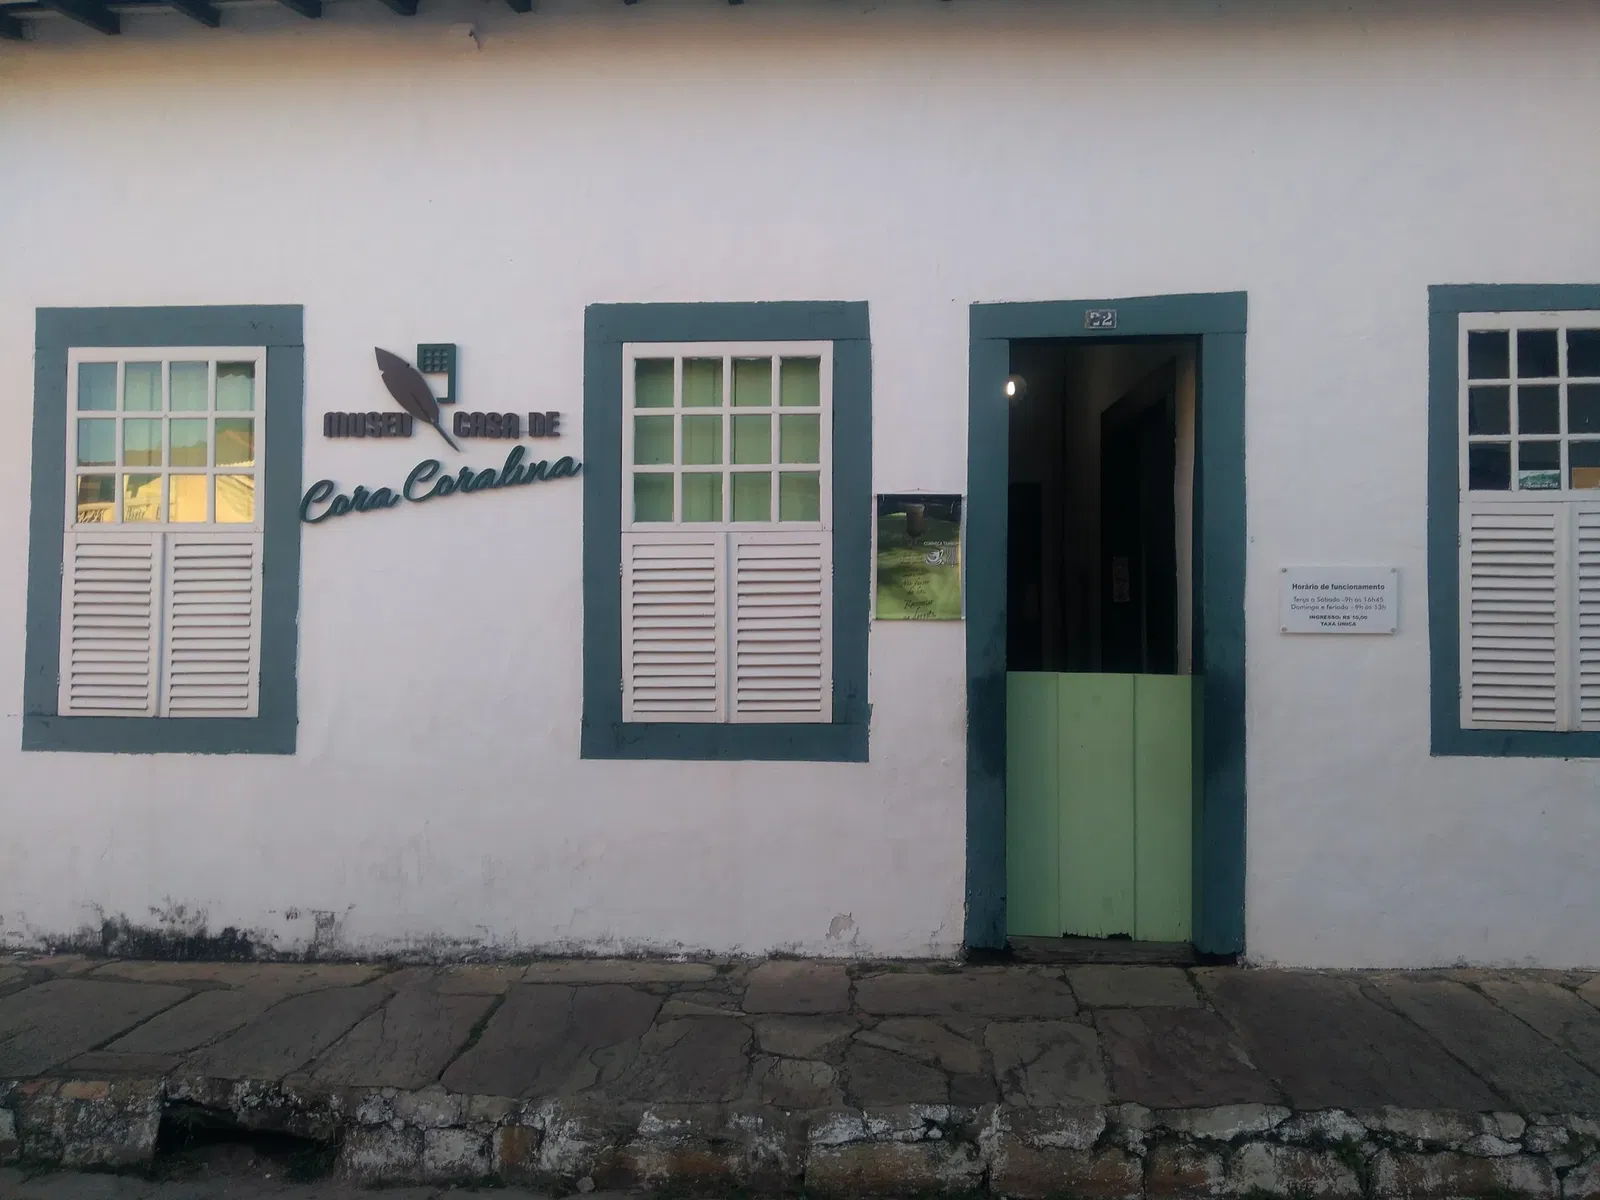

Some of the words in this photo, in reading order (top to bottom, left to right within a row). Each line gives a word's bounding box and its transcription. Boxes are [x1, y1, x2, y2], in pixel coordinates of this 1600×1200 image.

[323, 411, 413, 438] MUSEU
[453, 411, 520, 439] CASA
[528, 411, 561, 437] DE
[300, 479, 400, 524] Cora
[402, 445, 582, 503] Coralina
[1291, 603, 1320, 611] Domingo
